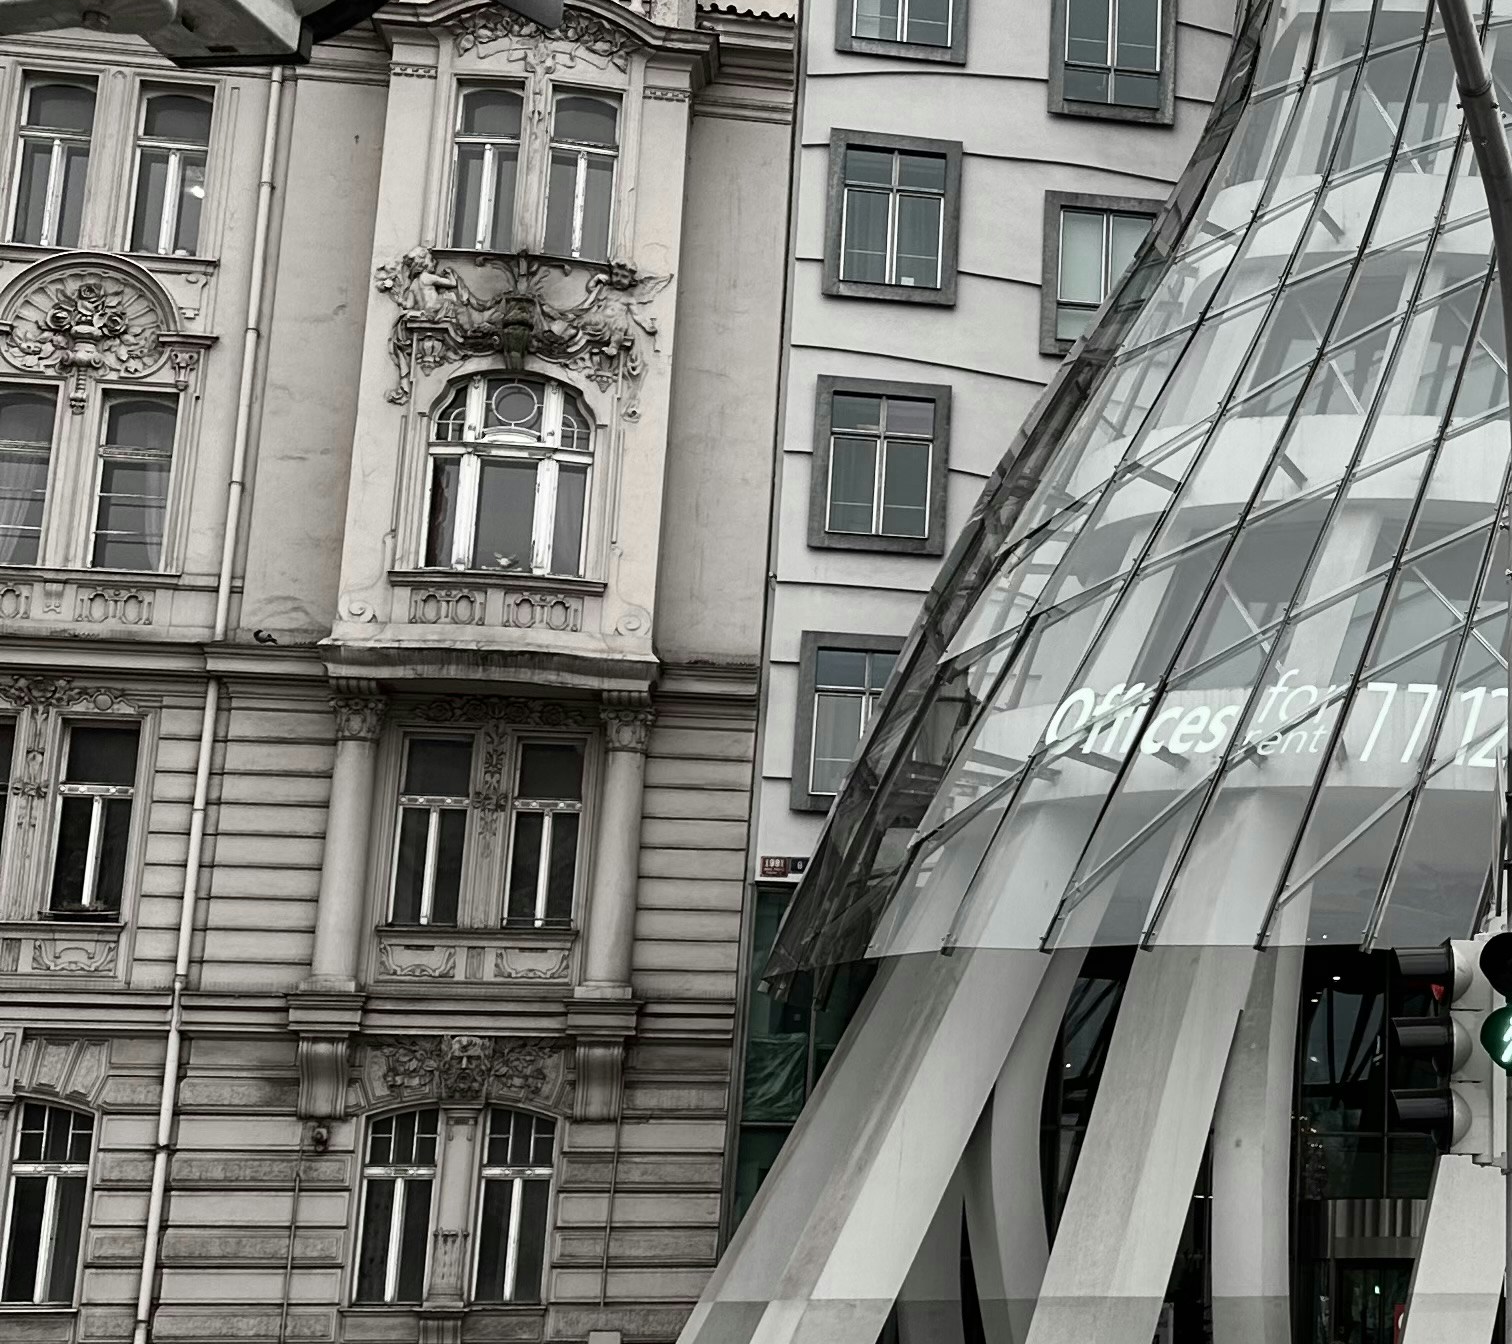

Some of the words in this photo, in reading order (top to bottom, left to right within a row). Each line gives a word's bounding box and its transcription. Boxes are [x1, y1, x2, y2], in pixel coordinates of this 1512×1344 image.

[1045, 682, 1241, 756] Offices
[1257, 668, 1338, 724] for
[1243, 725, 1333, 755] rent
